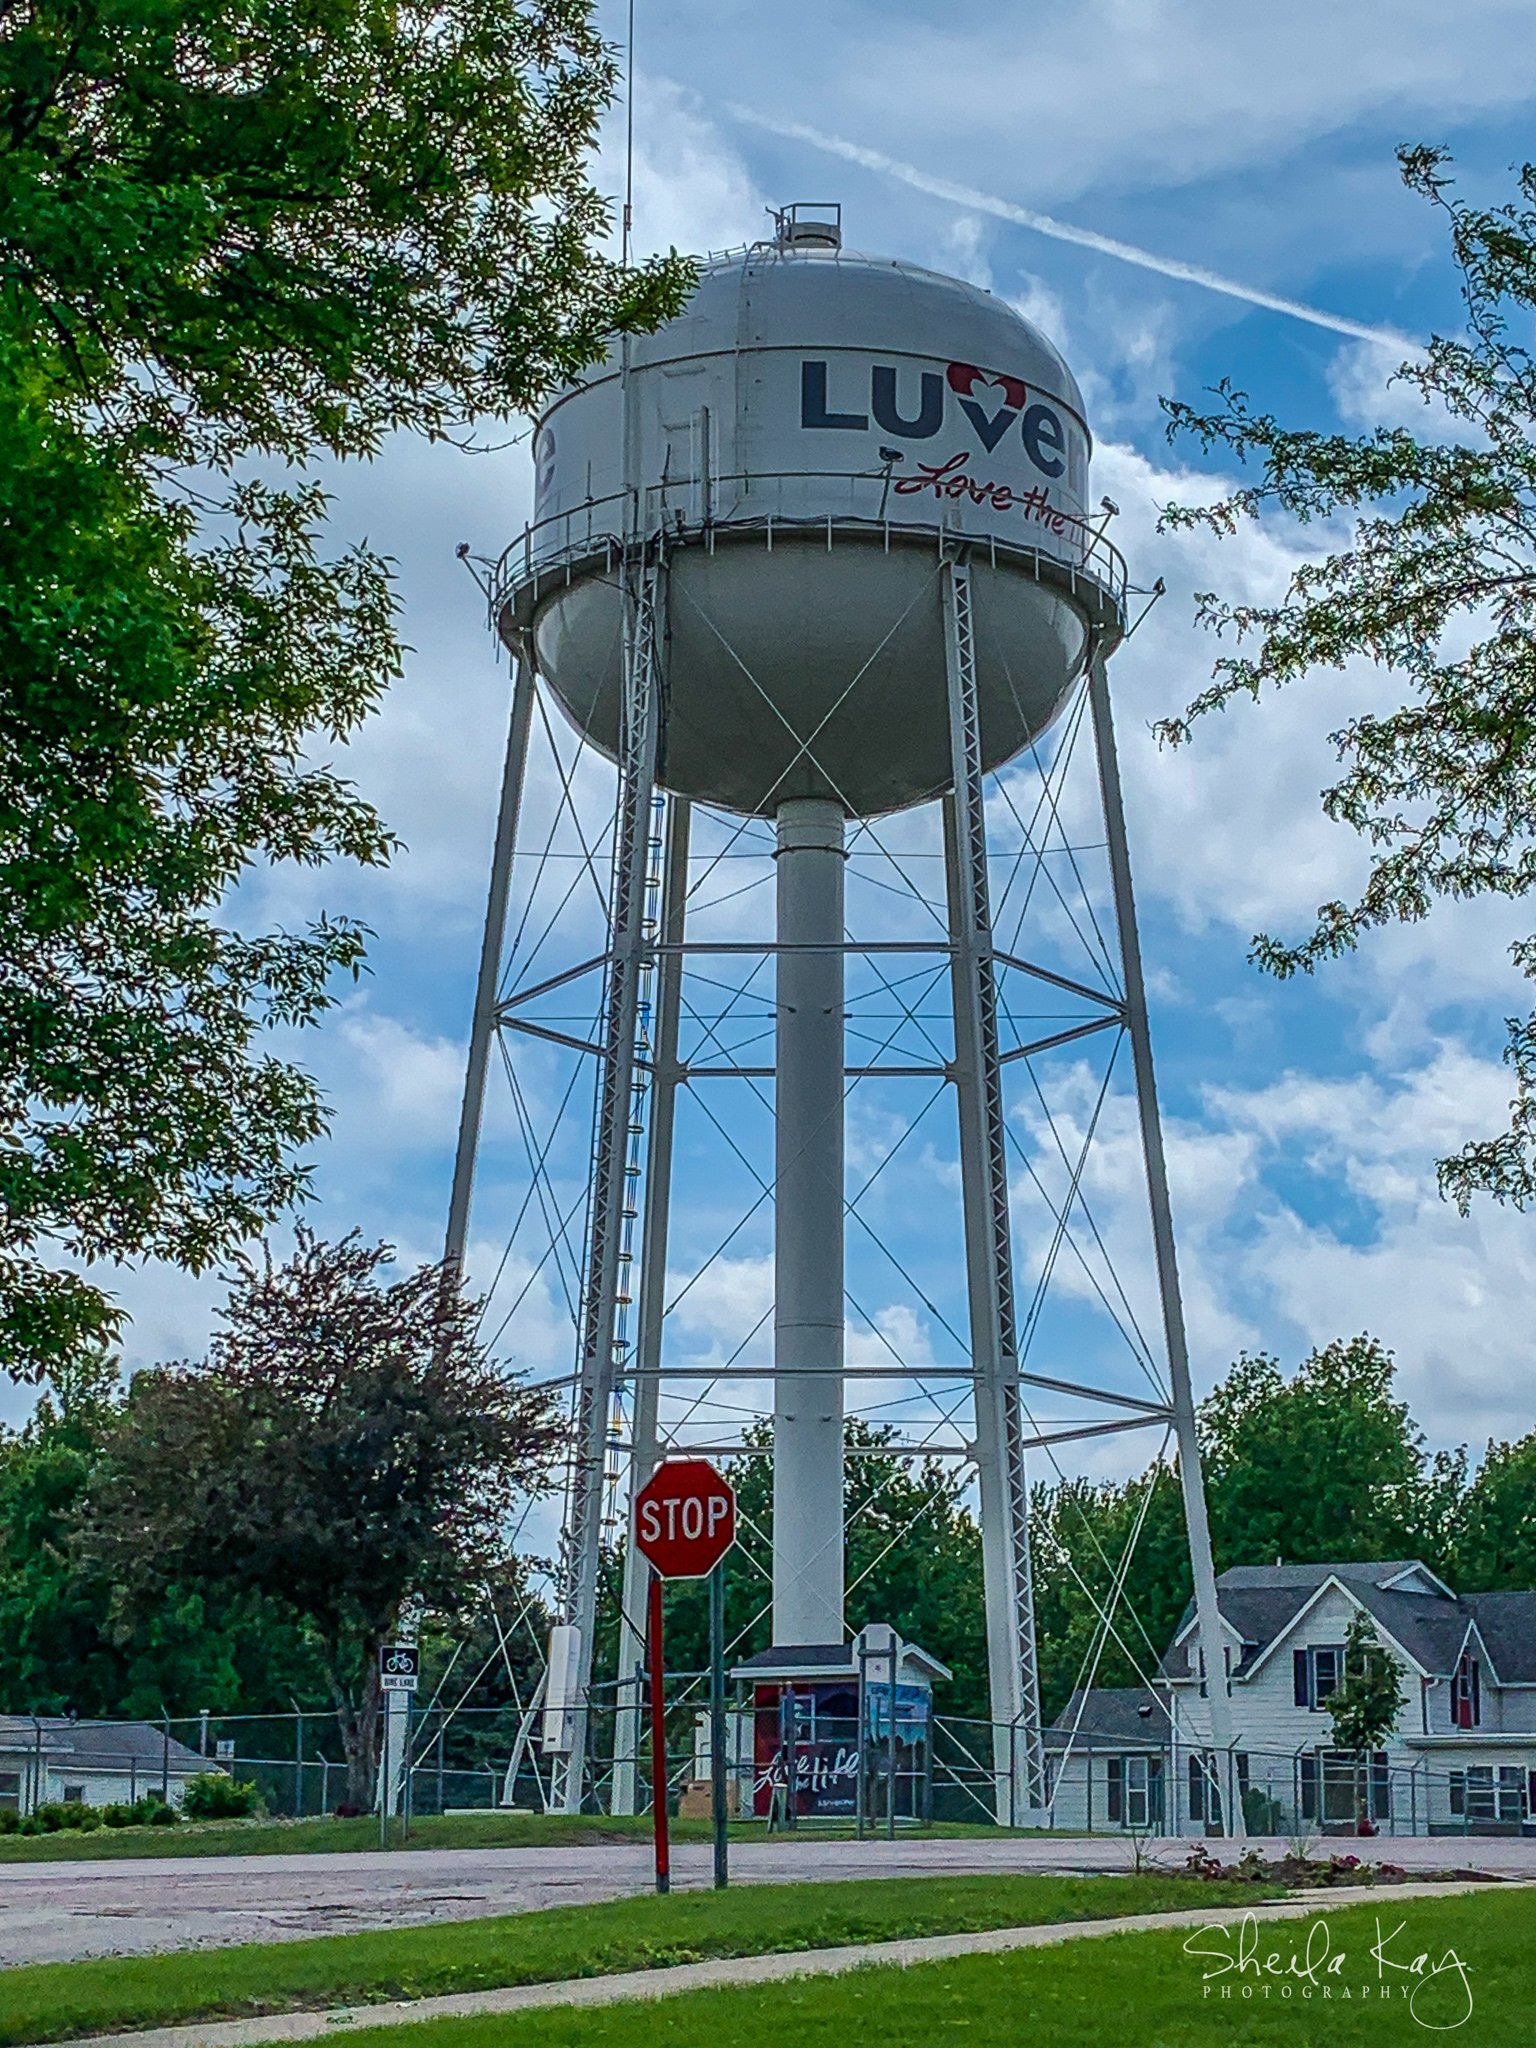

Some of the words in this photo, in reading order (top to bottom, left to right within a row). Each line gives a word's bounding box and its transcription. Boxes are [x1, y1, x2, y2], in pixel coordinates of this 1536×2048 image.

[893, 451, 1013, 511] Love
[1023, 485, 1066, 536] the
[641, 1496, 728, 1542] STOP
